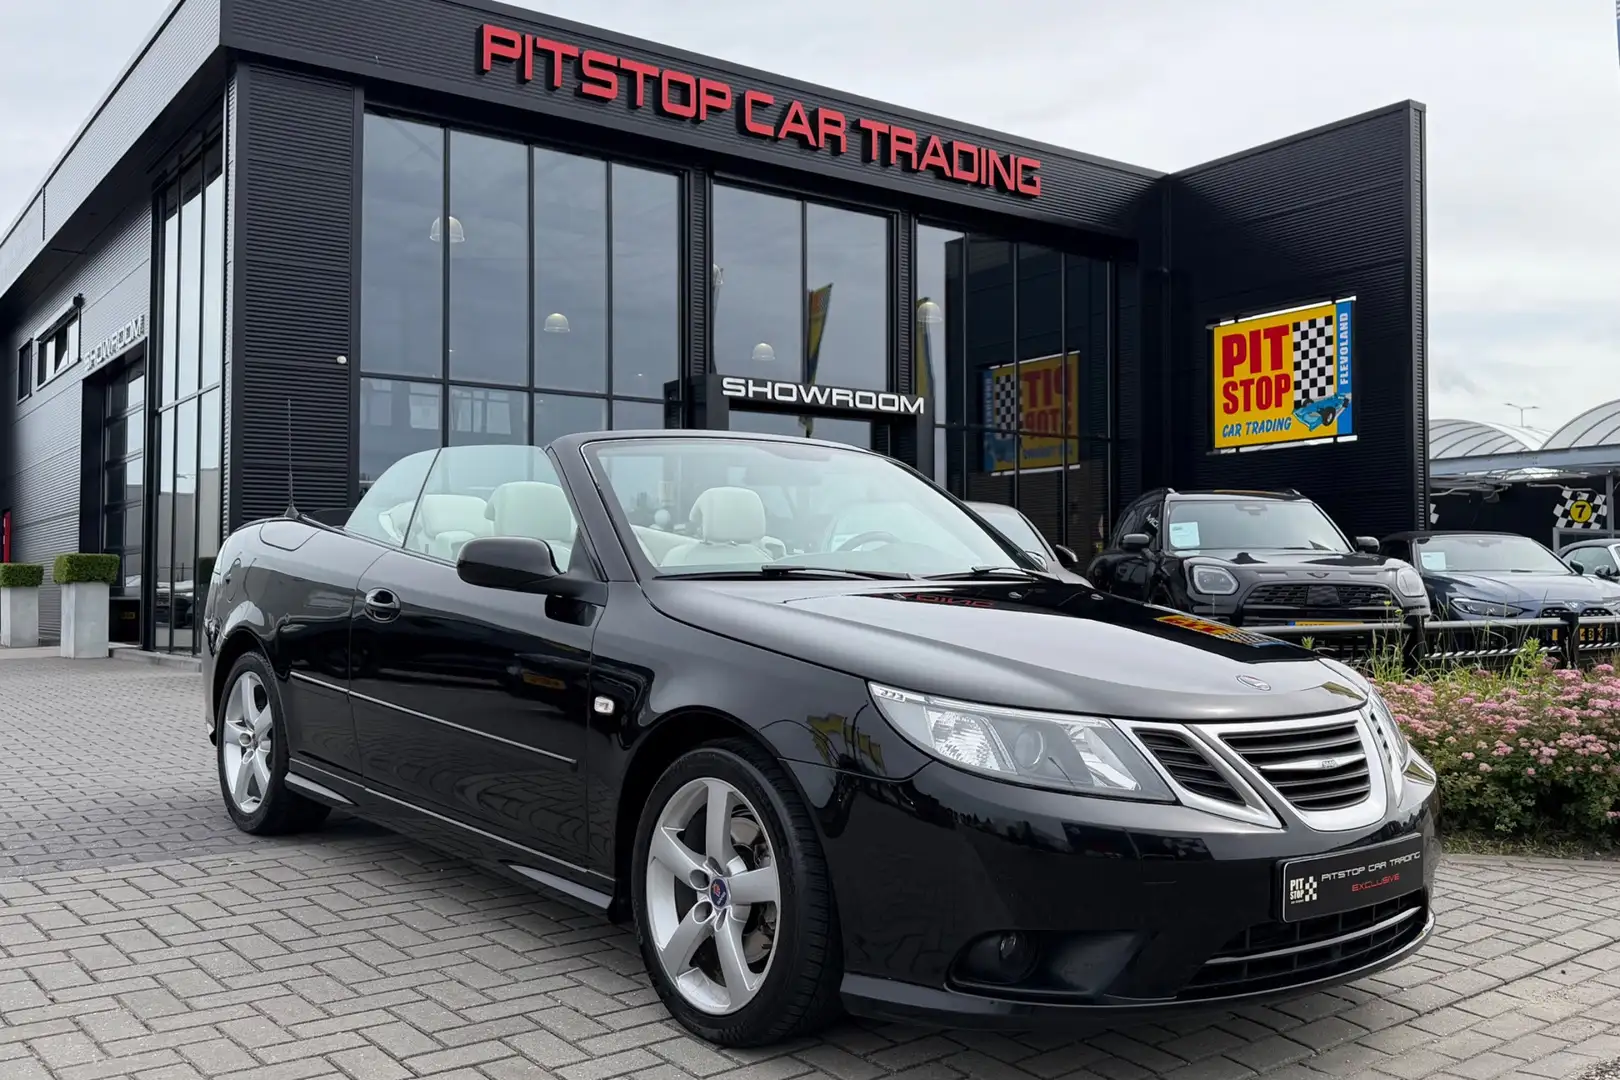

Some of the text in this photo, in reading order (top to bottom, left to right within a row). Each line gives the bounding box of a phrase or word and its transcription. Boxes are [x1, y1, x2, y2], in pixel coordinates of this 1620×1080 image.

[480, 23, 1041, 197] PITSTOP CAR TRADING
[1222, 324, 1289, 378] PIT
[1339, 312, 1349, 385] FLEVOLAND
[722, 377, 925, 414] SHOWROOM
[1222, 373, 1291, 415] STOP
[1222, 416, 1292, 438] CAR TRADING
[1575, 504, 1586, 519] 7
[1321, 851, 1421, 882] PITSTOP CAR TRADING
[1290, 877, 1305, 891] PIT
[1290, 889, 1305, 900] STOP
[1351, 873, 1400, 892] EXCLUSIVE
